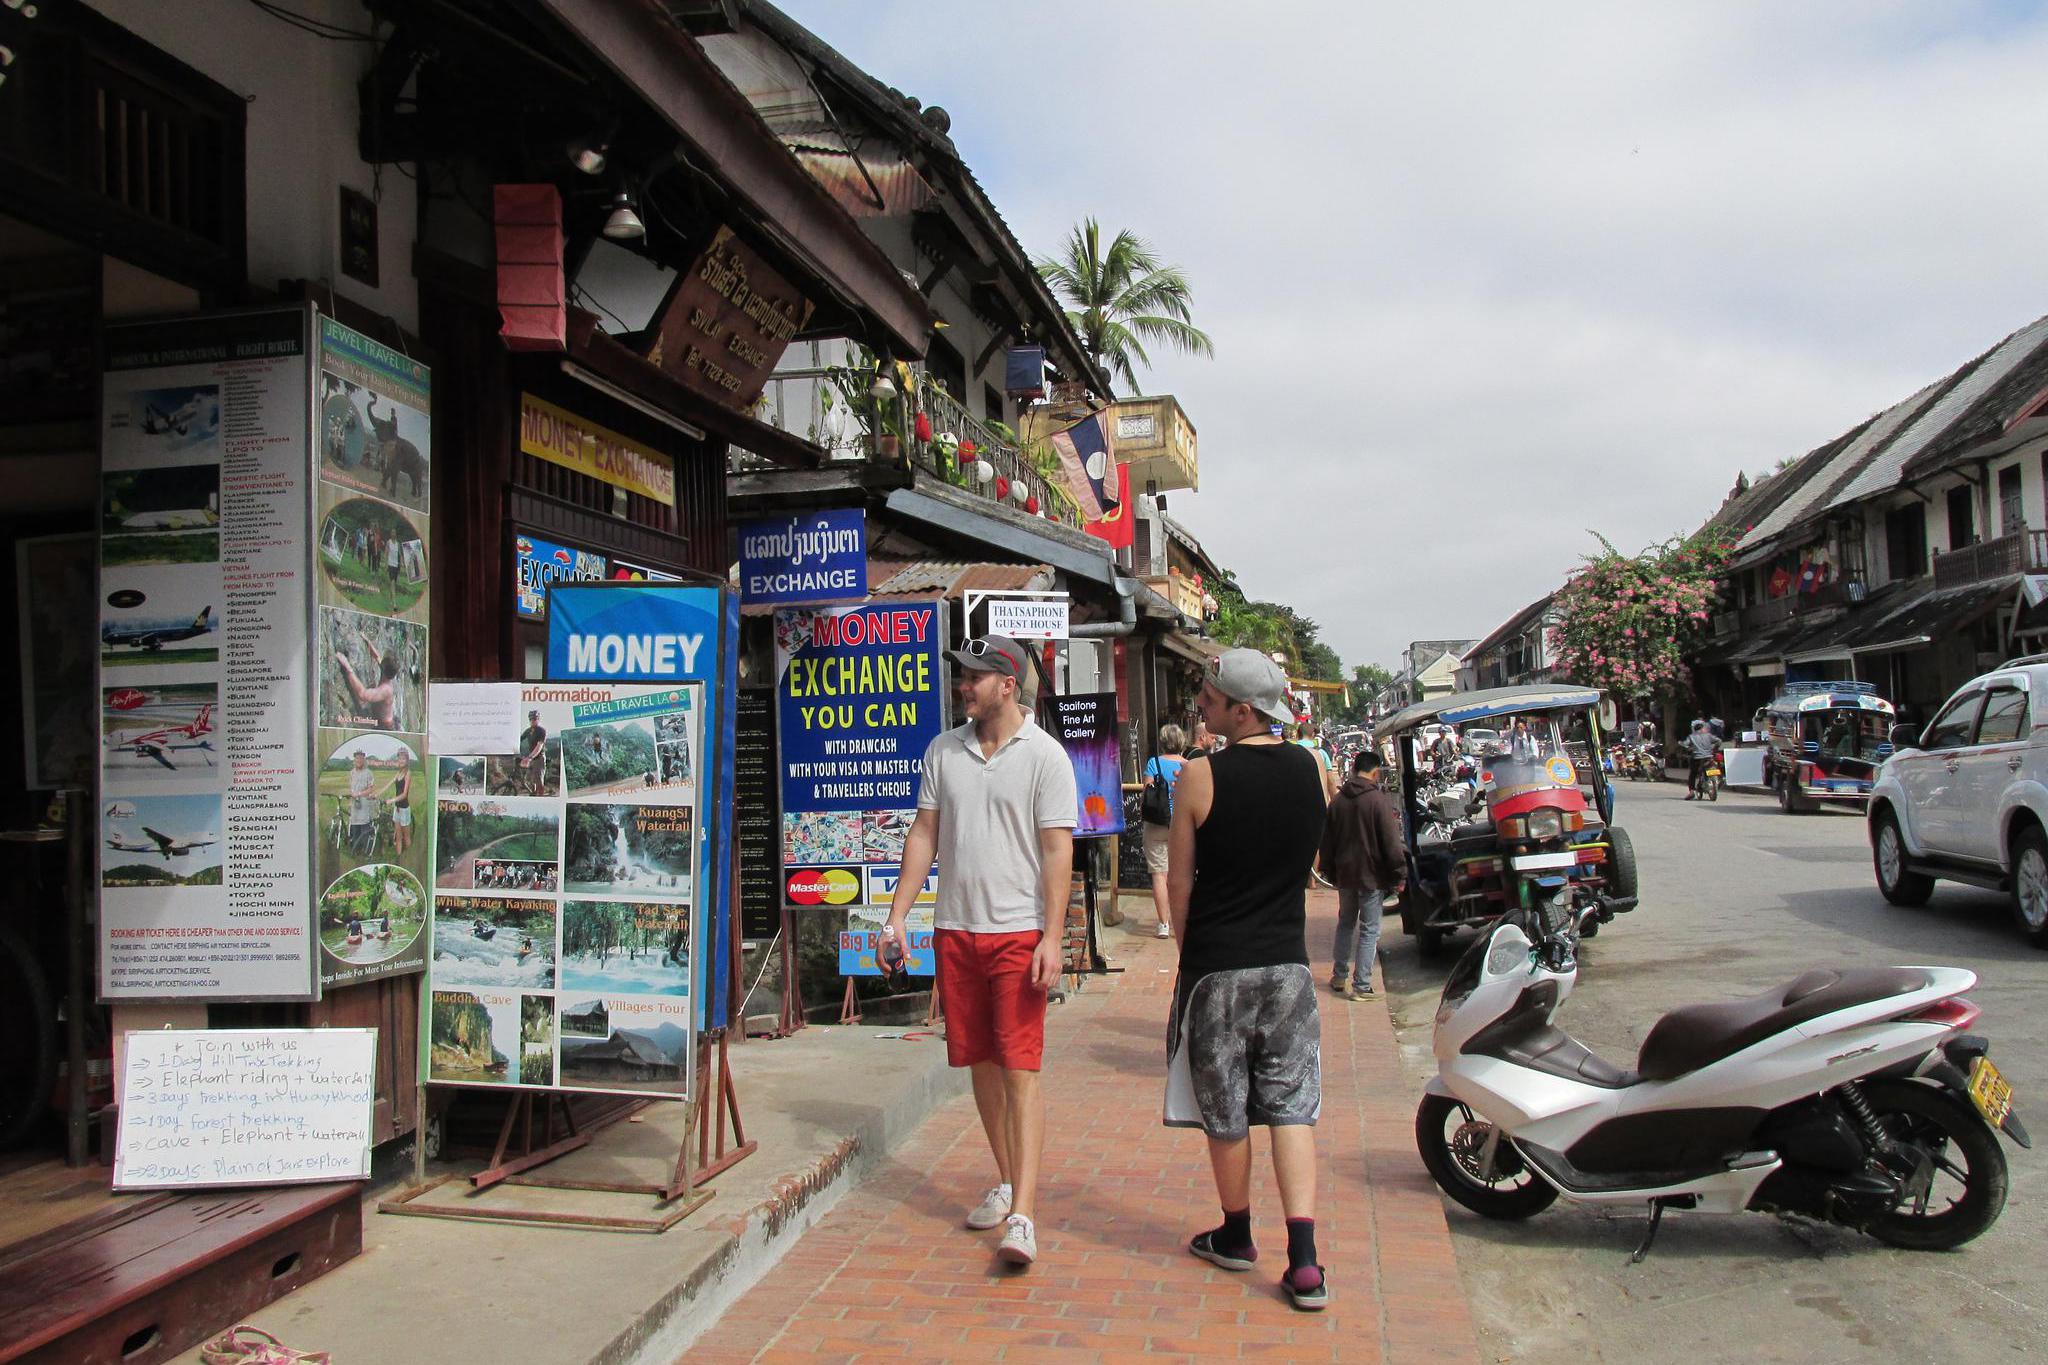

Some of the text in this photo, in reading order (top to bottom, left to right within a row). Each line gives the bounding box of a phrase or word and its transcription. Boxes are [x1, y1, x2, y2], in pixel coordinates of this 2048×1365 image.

[327, 323, 400, 369] JEWEL TRAVEL
[524, 402, 674, 496] MONEY EXCHANGE
[750, 569, 857, 594] EXCHANGE
[993, 605, 1065, 618] THATSAPHONE
[812, 610, 932, 648] MONEY
[995, 619, 1063, 629] GUEST HOUSE
[568, 633, 704, 675] MONEY
[789, 653, 930, 697] EXCHANGE
[522, 686, 612, 702] nformation
[579, 702, 613, 717] JEWEL
[616, 695, 654, 711] TRAVEL
[801, 702, 917, 730] YOU CAN
[1063, 713, 1095, 725] Fine Art
[1064, 728, 1096, 739] Gallery
[824, 738, 897, 755] WITH DRAWCASH
[789, 763, 811, 778] WITH
[813, 762, 837, 777] YOUR
[838, 761, 859, 776] VISA
[861, 760, 873, 775] OR
[875, 759, 910, 775] MASTER
[813, 781, 911, 799] & TRAVELLERS CHEQUE
[639, 807, 688, 820] KuangSi
[636, 820, 690, 833] Waterfall
[789, 882, 857, 893] MasterCard
[471, 897, 502, 909] Water
[505, 899, 556, 912] Kayaking
[634, 918, 688, 930] Waterfall
[841, 932, 863, 952] Big
[434, 992, 512, 1006] Buddha Cave
[608, 1000, 686, 1014] Villages Tour
[241, 1038, 274, 1052] with
[281, 1041, 297, 1051] us
[163, 1069, 234, 1088] Elephant
[240, 1069, 289, 1096] riding
[265, 1092, 283, 1102] in
[159, 1115, 184, 1134] Day
[221, 1127, 295, 1145] Elephant
